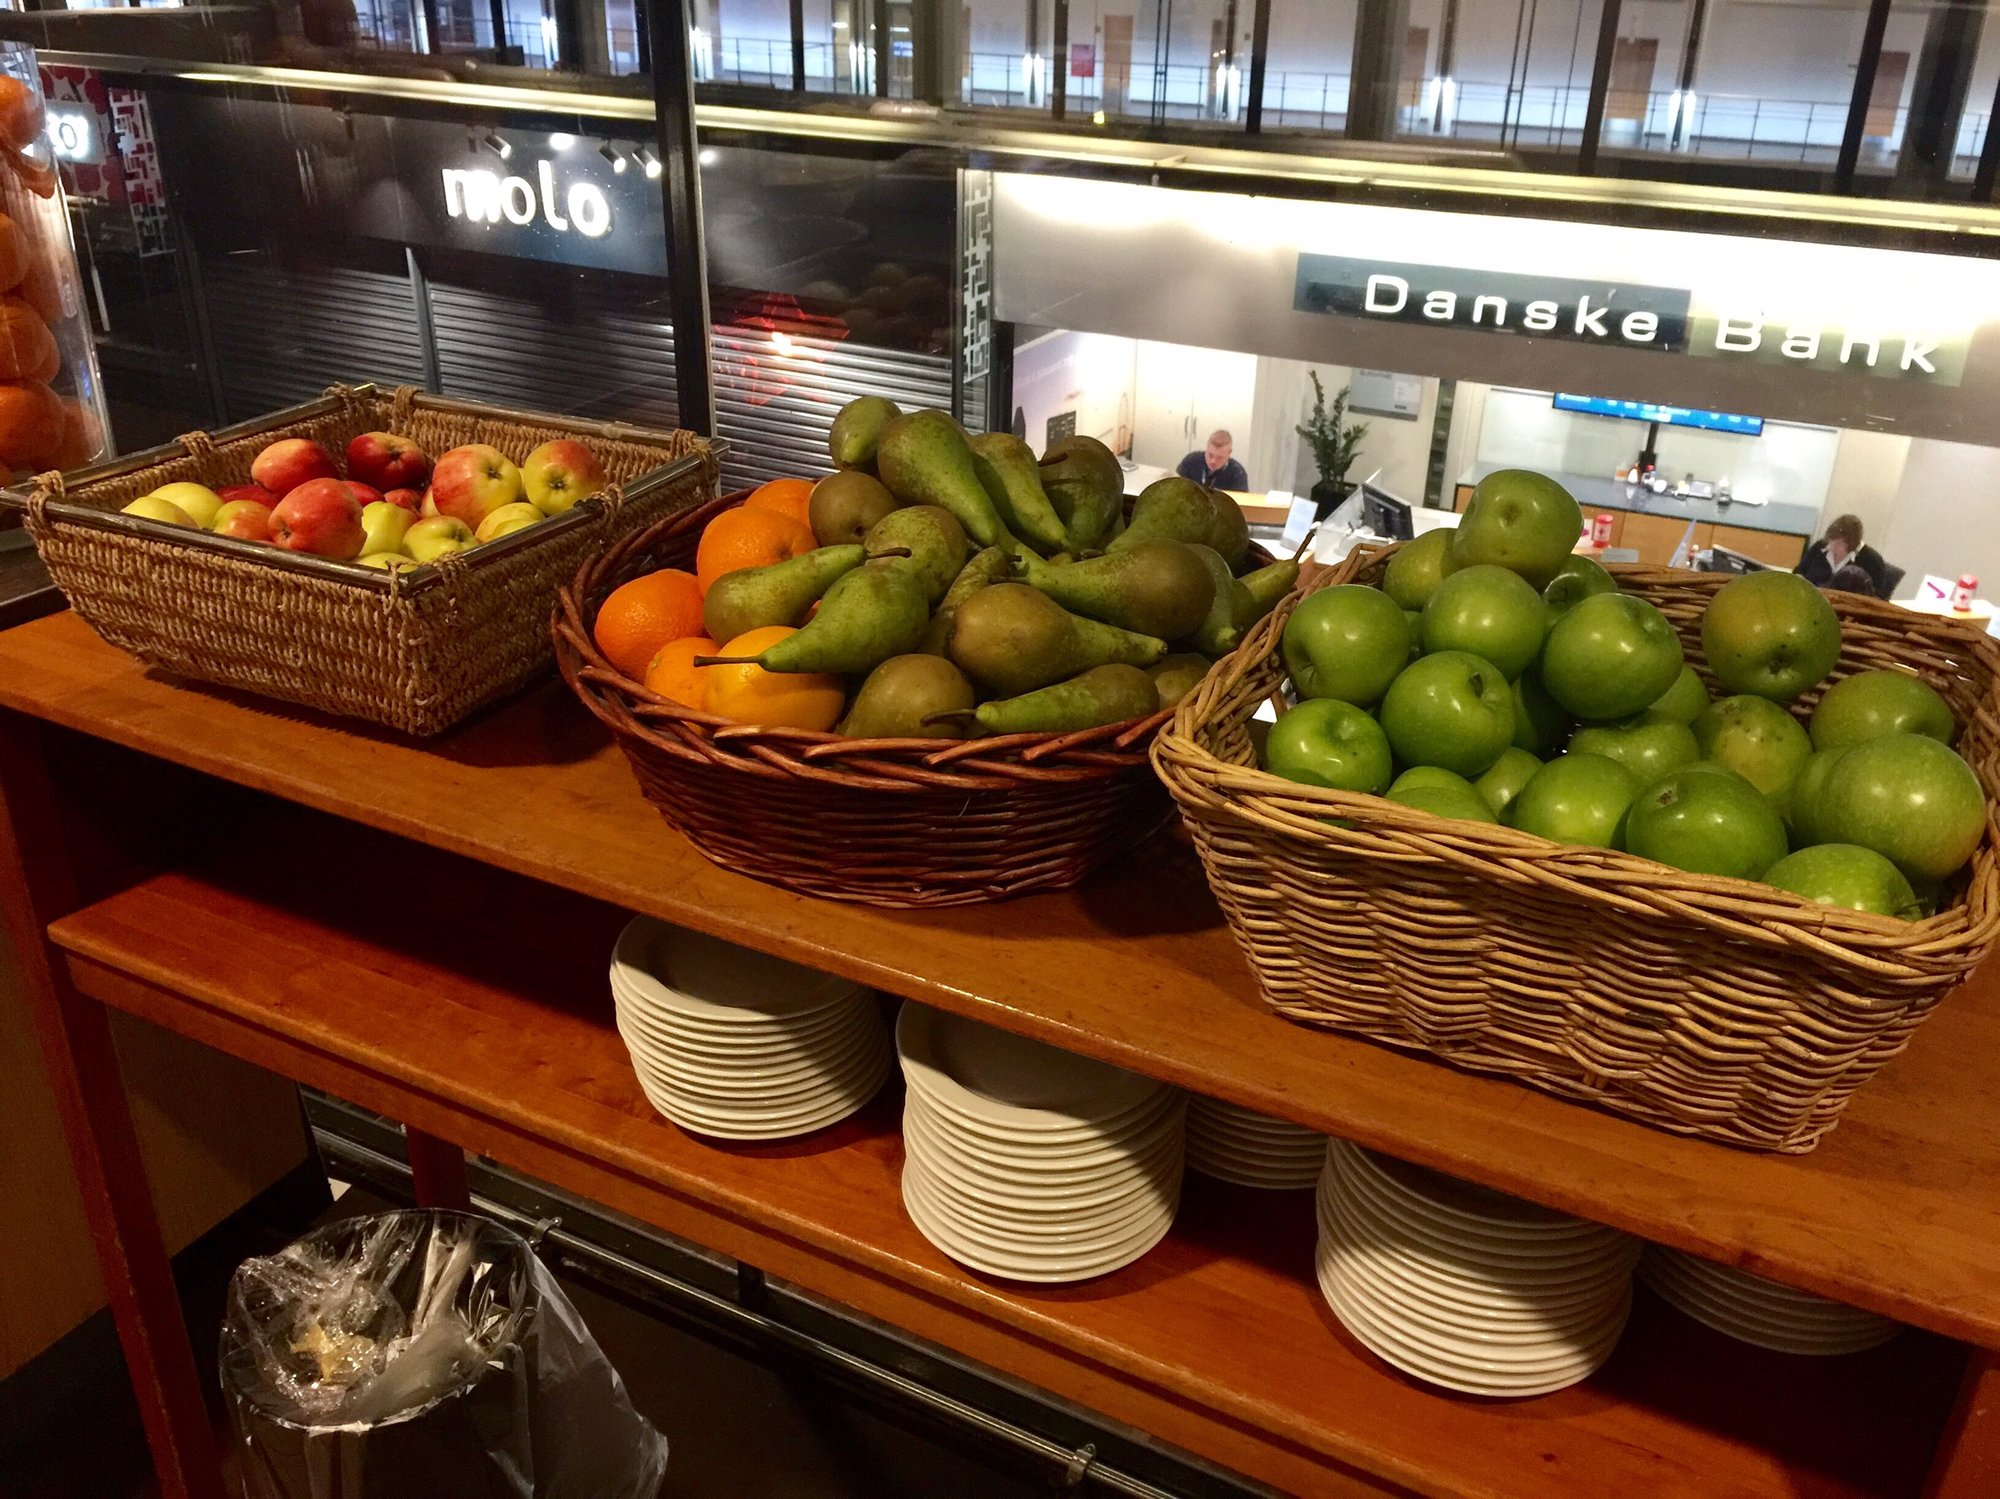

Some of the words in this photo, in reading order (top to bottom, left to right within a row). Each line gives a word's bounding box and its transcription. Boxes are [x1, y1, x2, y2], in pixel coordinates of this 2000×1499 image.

[442, 160, 611, 238] molo
[1364, 273, 1660, 344] Danske
[1715, 309, 1940, 374] Bank
